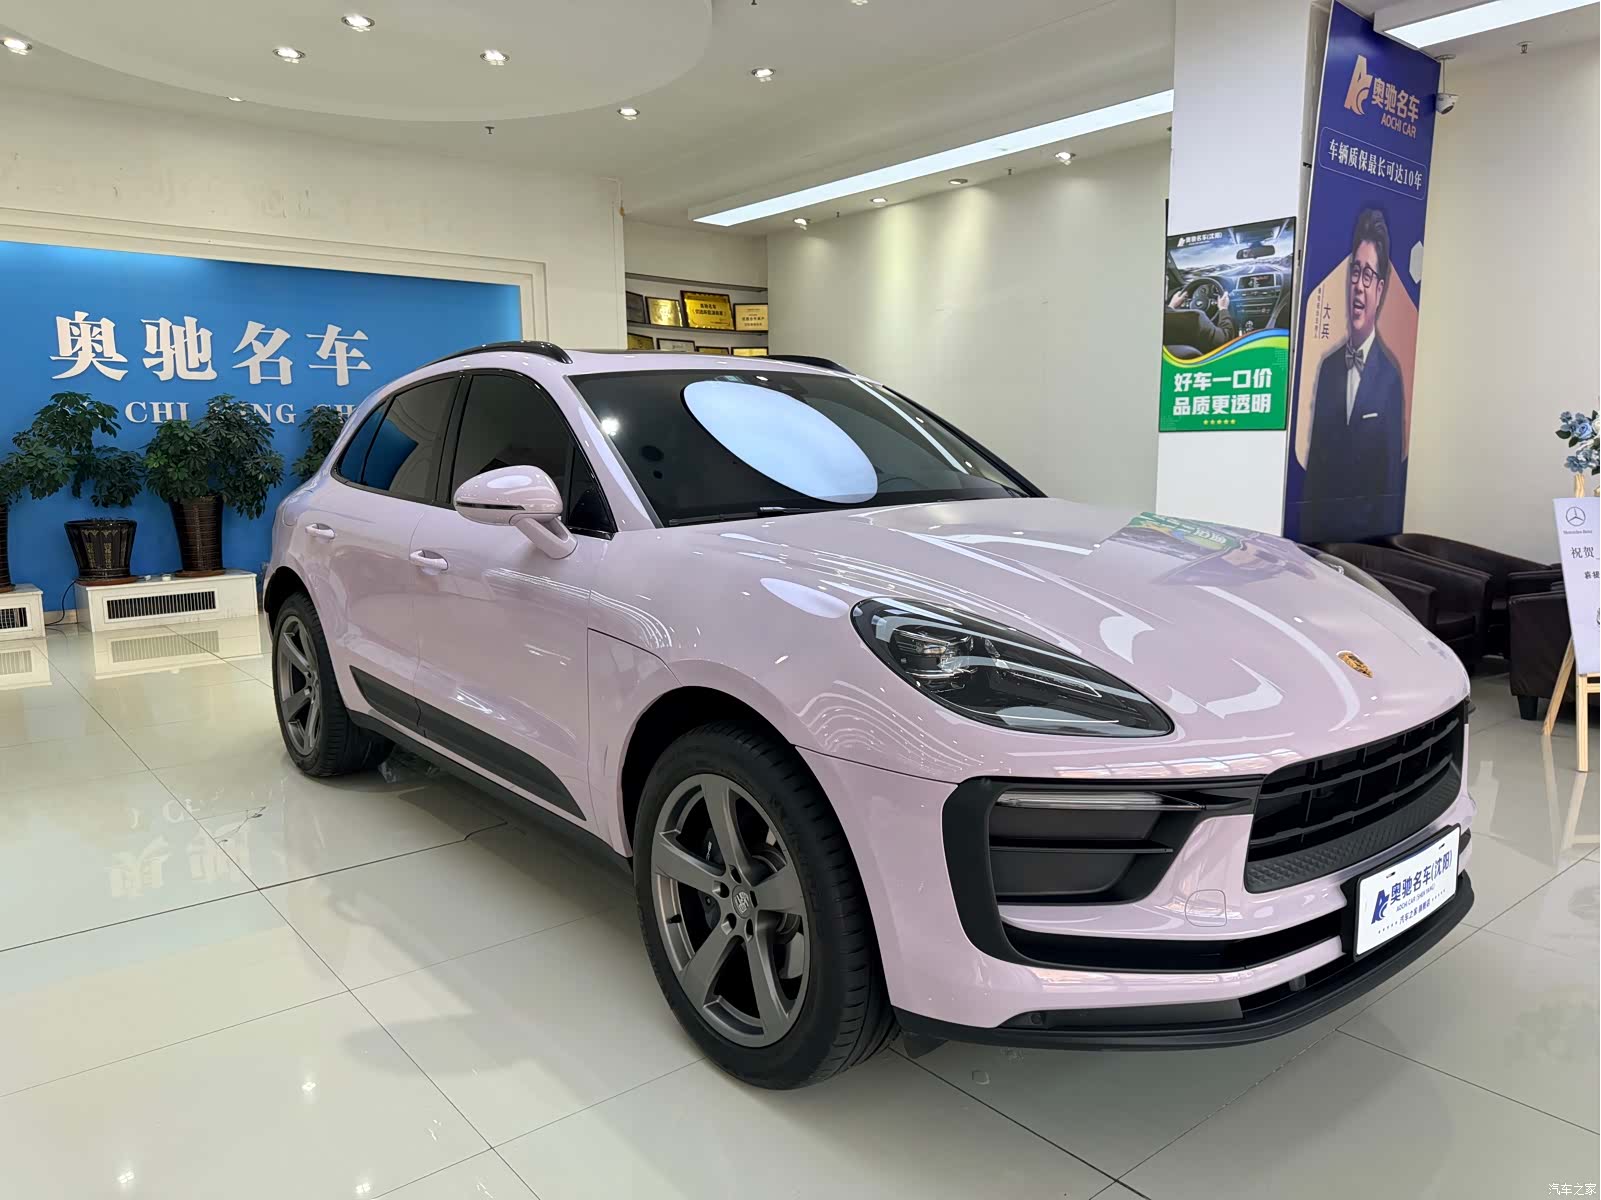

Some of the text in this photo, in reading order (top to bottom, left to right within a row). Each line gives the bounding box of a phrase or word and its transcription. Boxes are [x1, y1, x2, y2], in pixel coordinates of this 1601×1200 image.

[1371, 77, 1420, 123] 奥驰名车
[1381, 113, 1417, 140] AOCHI CAR
[1328, 139, 1423, 191] 车辆质保最长可达10年
[1321, 303, 1331, 340] 大兵
[49, 311, 372, 386] 奥驰名车
[1173, 367, 1273, 392] 好车一口价
[124, 401, 190, 424] CHI
[1172, 393, 1272, 416] 品质更透明
[1570, 546, 1595, 559] 祝贺
[1390, 849, 1453, 905] 奥驰名车(沈阳)
